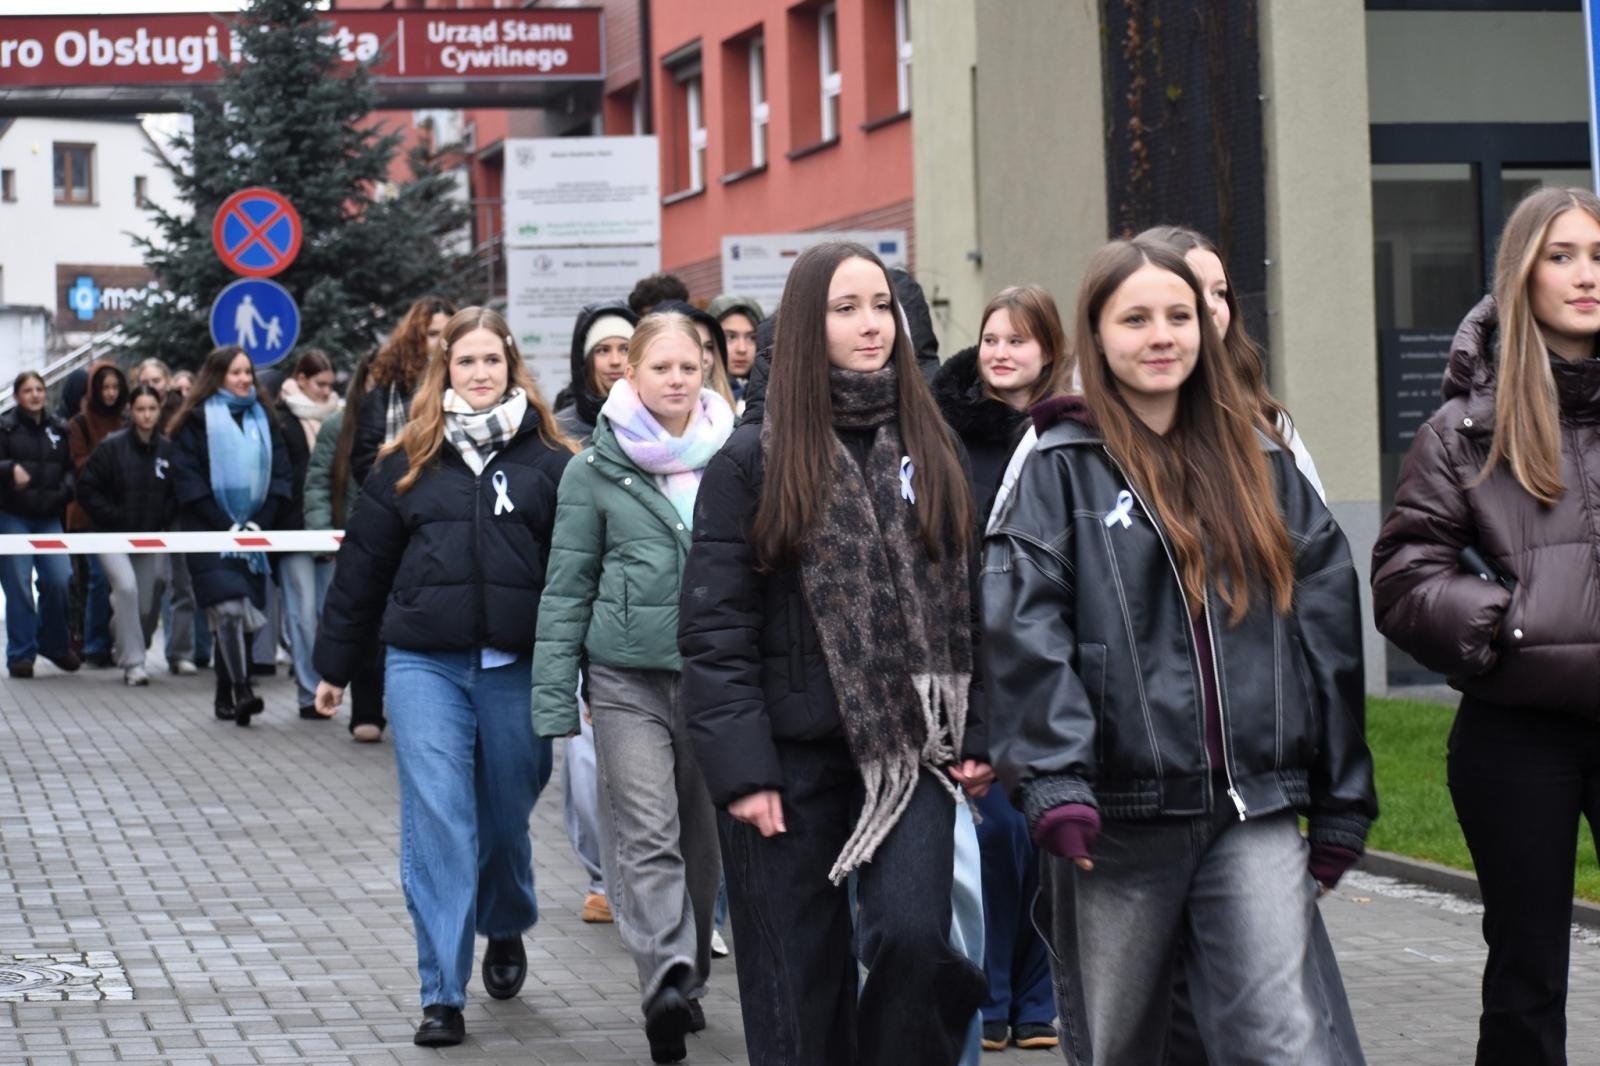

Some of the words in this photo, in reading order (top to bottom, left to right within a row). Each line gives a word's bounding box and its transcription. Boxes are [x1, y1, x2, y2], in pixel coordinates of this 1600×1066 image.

[427, 20, 498, 48] Urząd
[502, 19, 573, 42] Stanu
[54, 25, 219, 74] Obsługi
[440, 44, 568, 74] Cywilnego
